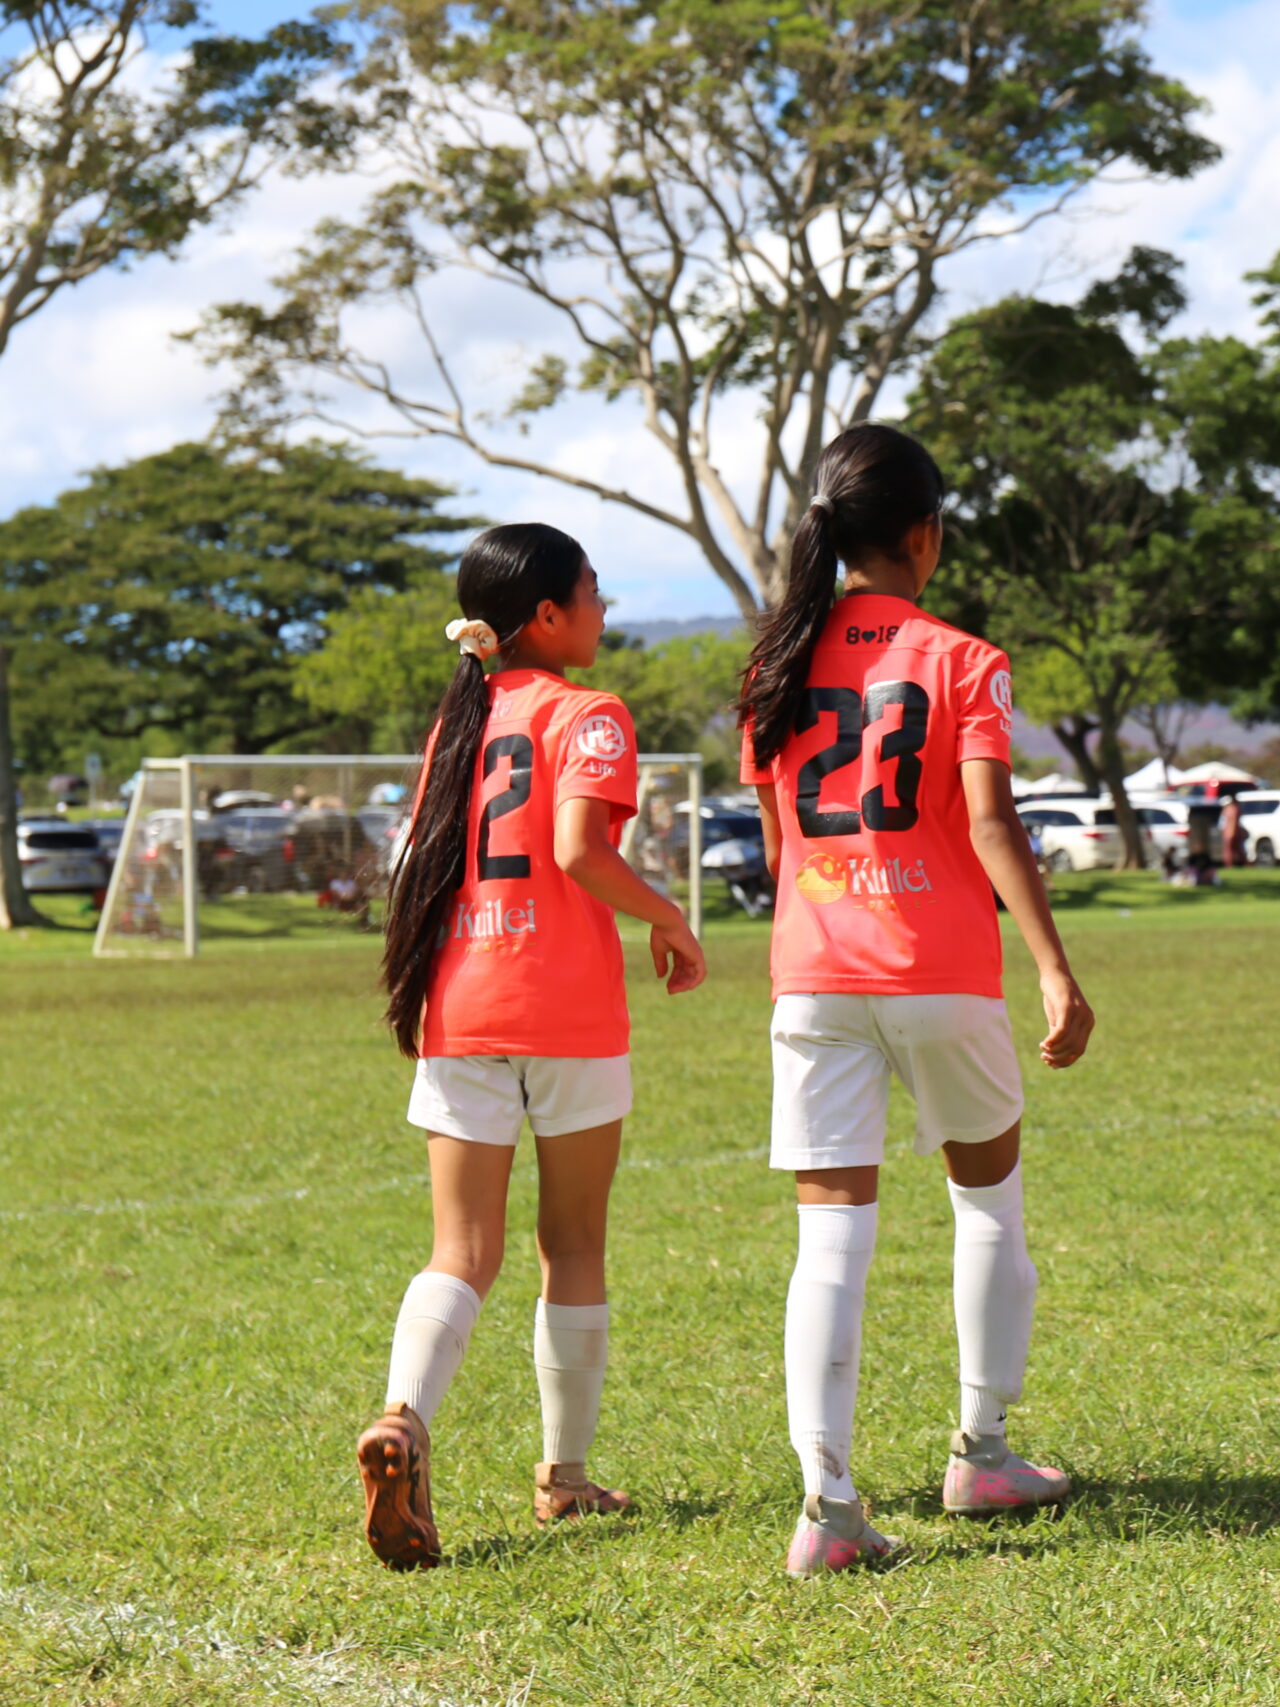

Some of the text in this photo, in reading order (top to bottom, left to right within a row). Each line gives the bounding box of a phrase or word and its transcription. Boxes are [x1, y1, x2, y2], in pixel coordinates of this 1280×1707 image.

[795, 680, 929, 838] 23
[477, 733, 533, 882] 2
[454, 899, 537, 938] Kuilei
[848, 857, 934, 895] Kuilei
